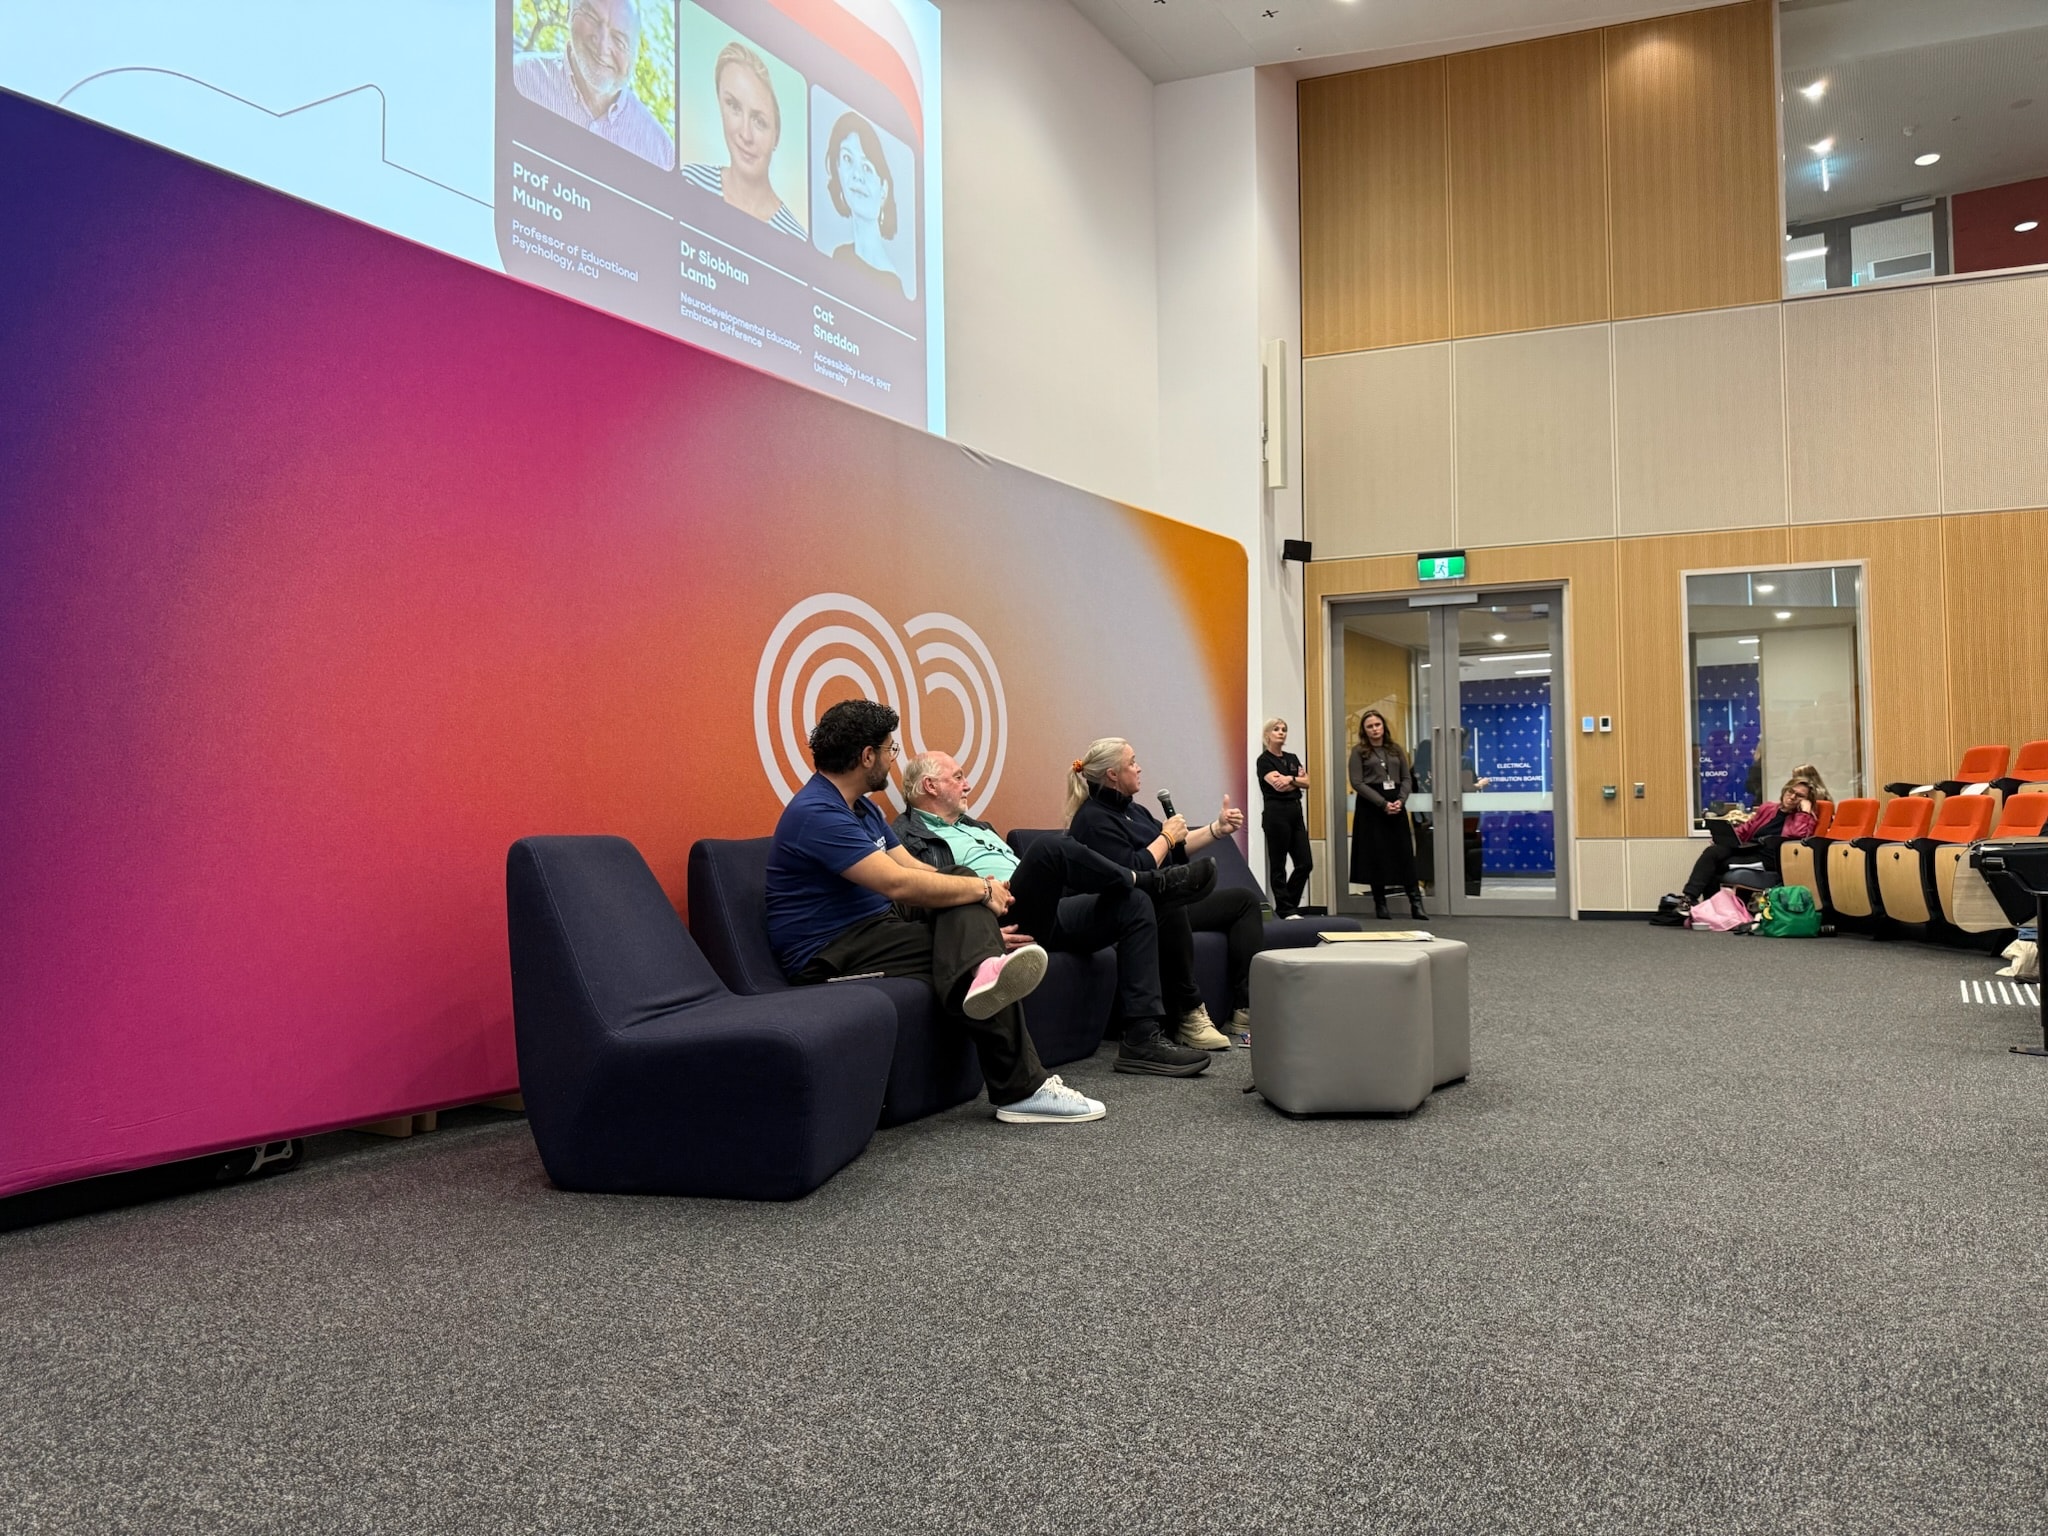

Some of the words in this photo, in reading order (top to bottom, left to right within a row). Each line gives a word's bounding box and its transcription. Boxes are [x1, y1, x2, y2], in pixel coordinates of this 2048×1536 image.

[512, 185, 563, 221] Munro
[513, 161, 549, 191] Prof
[552, 182, 591, 212] John
[512, 219, 565, 250] Professor
[567, 245, 579, 256] of
[581, 248, 639, 282] Educational
[512, 234, 575, 271] Psychology,
[577, 262, 599, 279] ACU
[680, 240, 696, 259] Dr
[698, 249, 749, 285] Siobhan
[680, 261, 717, 290] Lamb
[680, 291, 765, 337] Neurodevelopmental
[765, 328, 802, 355] Educator,
[680, 304, 719, 329] Embrace
[719, 321, 763, 348] Difference
[813, 304, 835, 326] Cat
[813, 323, 860, 357] Sneddon
[813, 351, 857, 379] Accessibility
[857, 369, 876, 386] Lead,
[813, 362, 848, 387] University
